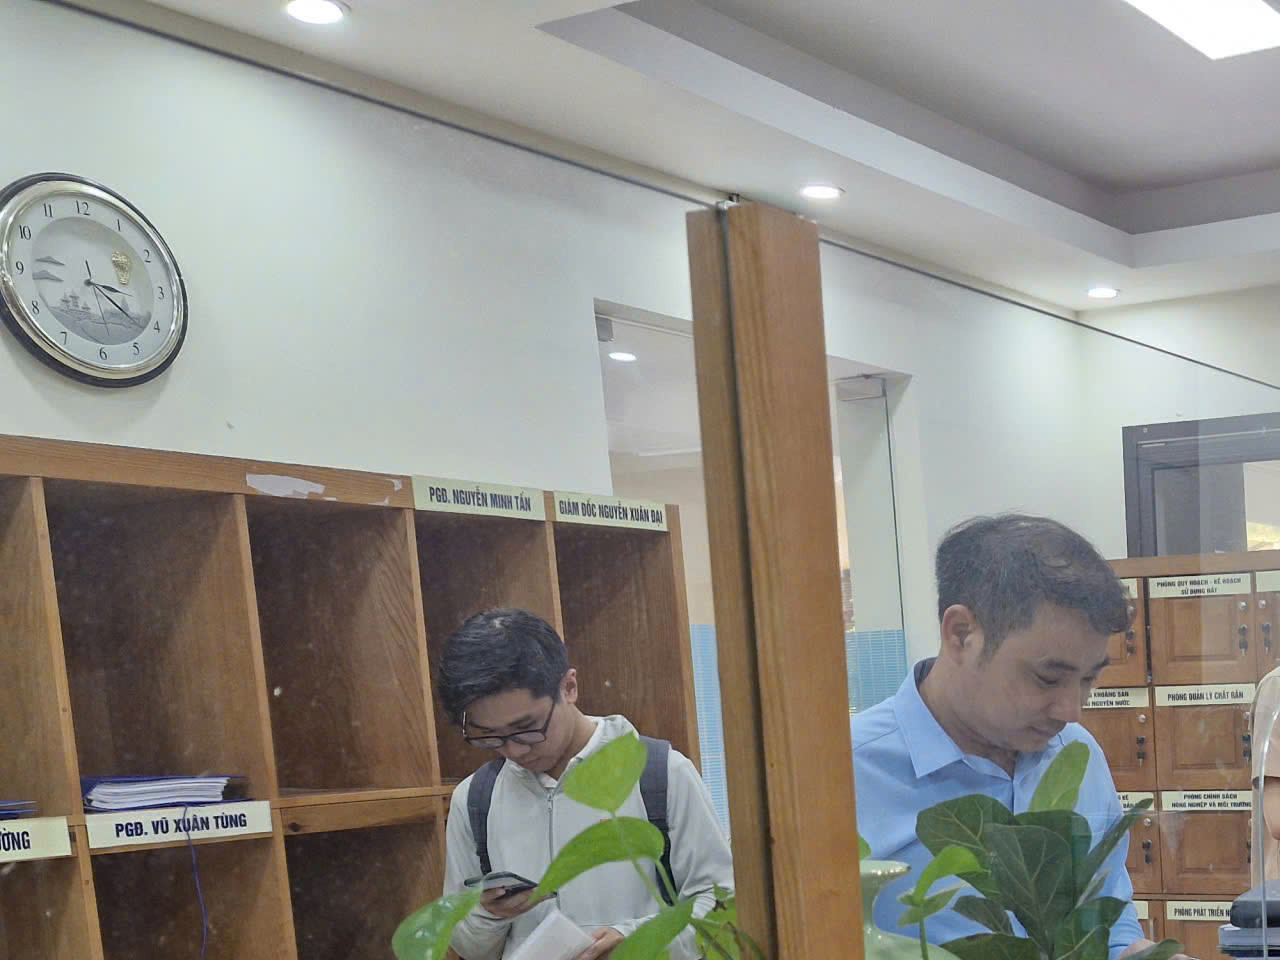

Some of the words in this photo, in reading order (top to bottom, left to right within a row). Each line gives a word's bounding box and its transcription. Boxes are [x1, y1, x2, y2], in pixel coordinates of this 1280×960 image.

[43, 203, 53, 217] 11
[75, 200, 90, 216] 12
[116, 218, 122, 232] 1
[19, 225, 32, 240] 10
[143, 249, 152, 264] 2
[15, 261, 24, 275] 9
[157, 286, 165, 300] 3
[31, 300, 40, 314] 8
[153, 320, 161, 334] 4
[60, 331, 68, 345] 7
[99, 347, 108, 360] 6
[132, 342, 140, 355] 5
[428, 486, 450, 504] PGĐ.
[452, 485, 488, 507] NGUYỄN
[490, 493, 513, 510] MINH
[630, 505, 650, 523] XUÂN
[115, 821, 148, 838] PGĐ.
[152, 816, 169, 835] VŨ
[174, 814, 210, 833] XUÂN
[215, 813, 247, 830] TÙNG
[0, 828, 31, 851] ỜNG
